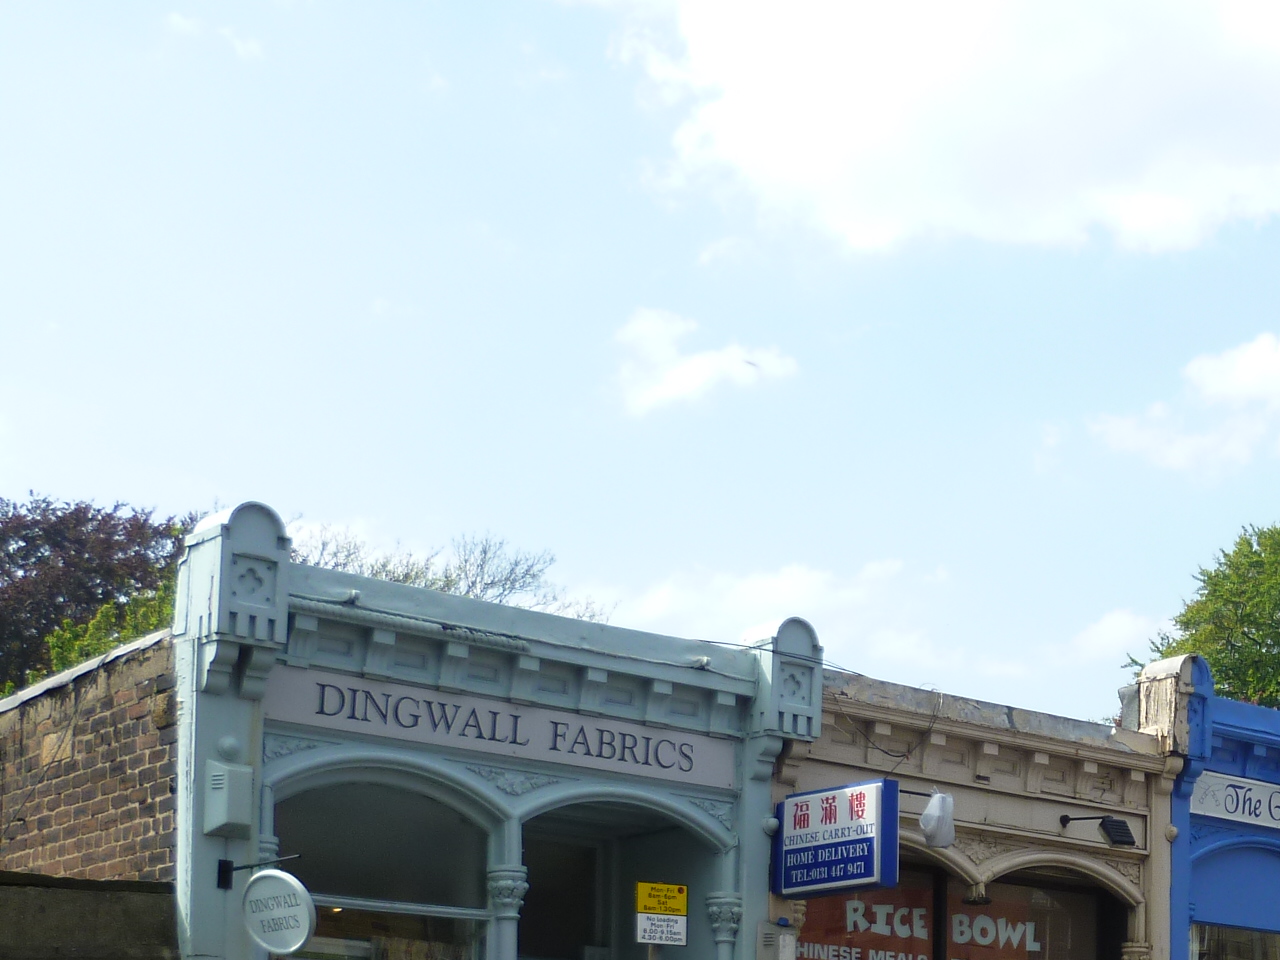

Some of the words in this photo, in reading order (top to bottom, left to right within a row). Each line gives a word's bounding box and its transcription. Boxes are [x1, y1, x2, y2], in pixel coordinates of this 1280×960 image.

[315, 682, 530, 746] DINGWALL
[549, 720, 694, 772] FABRICS
[793, 790, 866, 830] 福滿樓
[1224, 783, 1262, 818] The
[784, 831, 820, 847] CHINESE
[822, 823, 875, 841] CARRY-OUT
[787, 850, 815, 867] HOME
[818, 842, 870, 862] DELIVERY
[791, 866, 828, 883] TEL:0131
[830, 864, 845, 878] 447
[847, 861, 865, 875] 9471
[249, 893, 301, 914] DINGWALL
[260, 914, 300, 933] FABRICS
[845, 900, 929, 941] RICE
[951, 913, 1041, 952] BOWL
